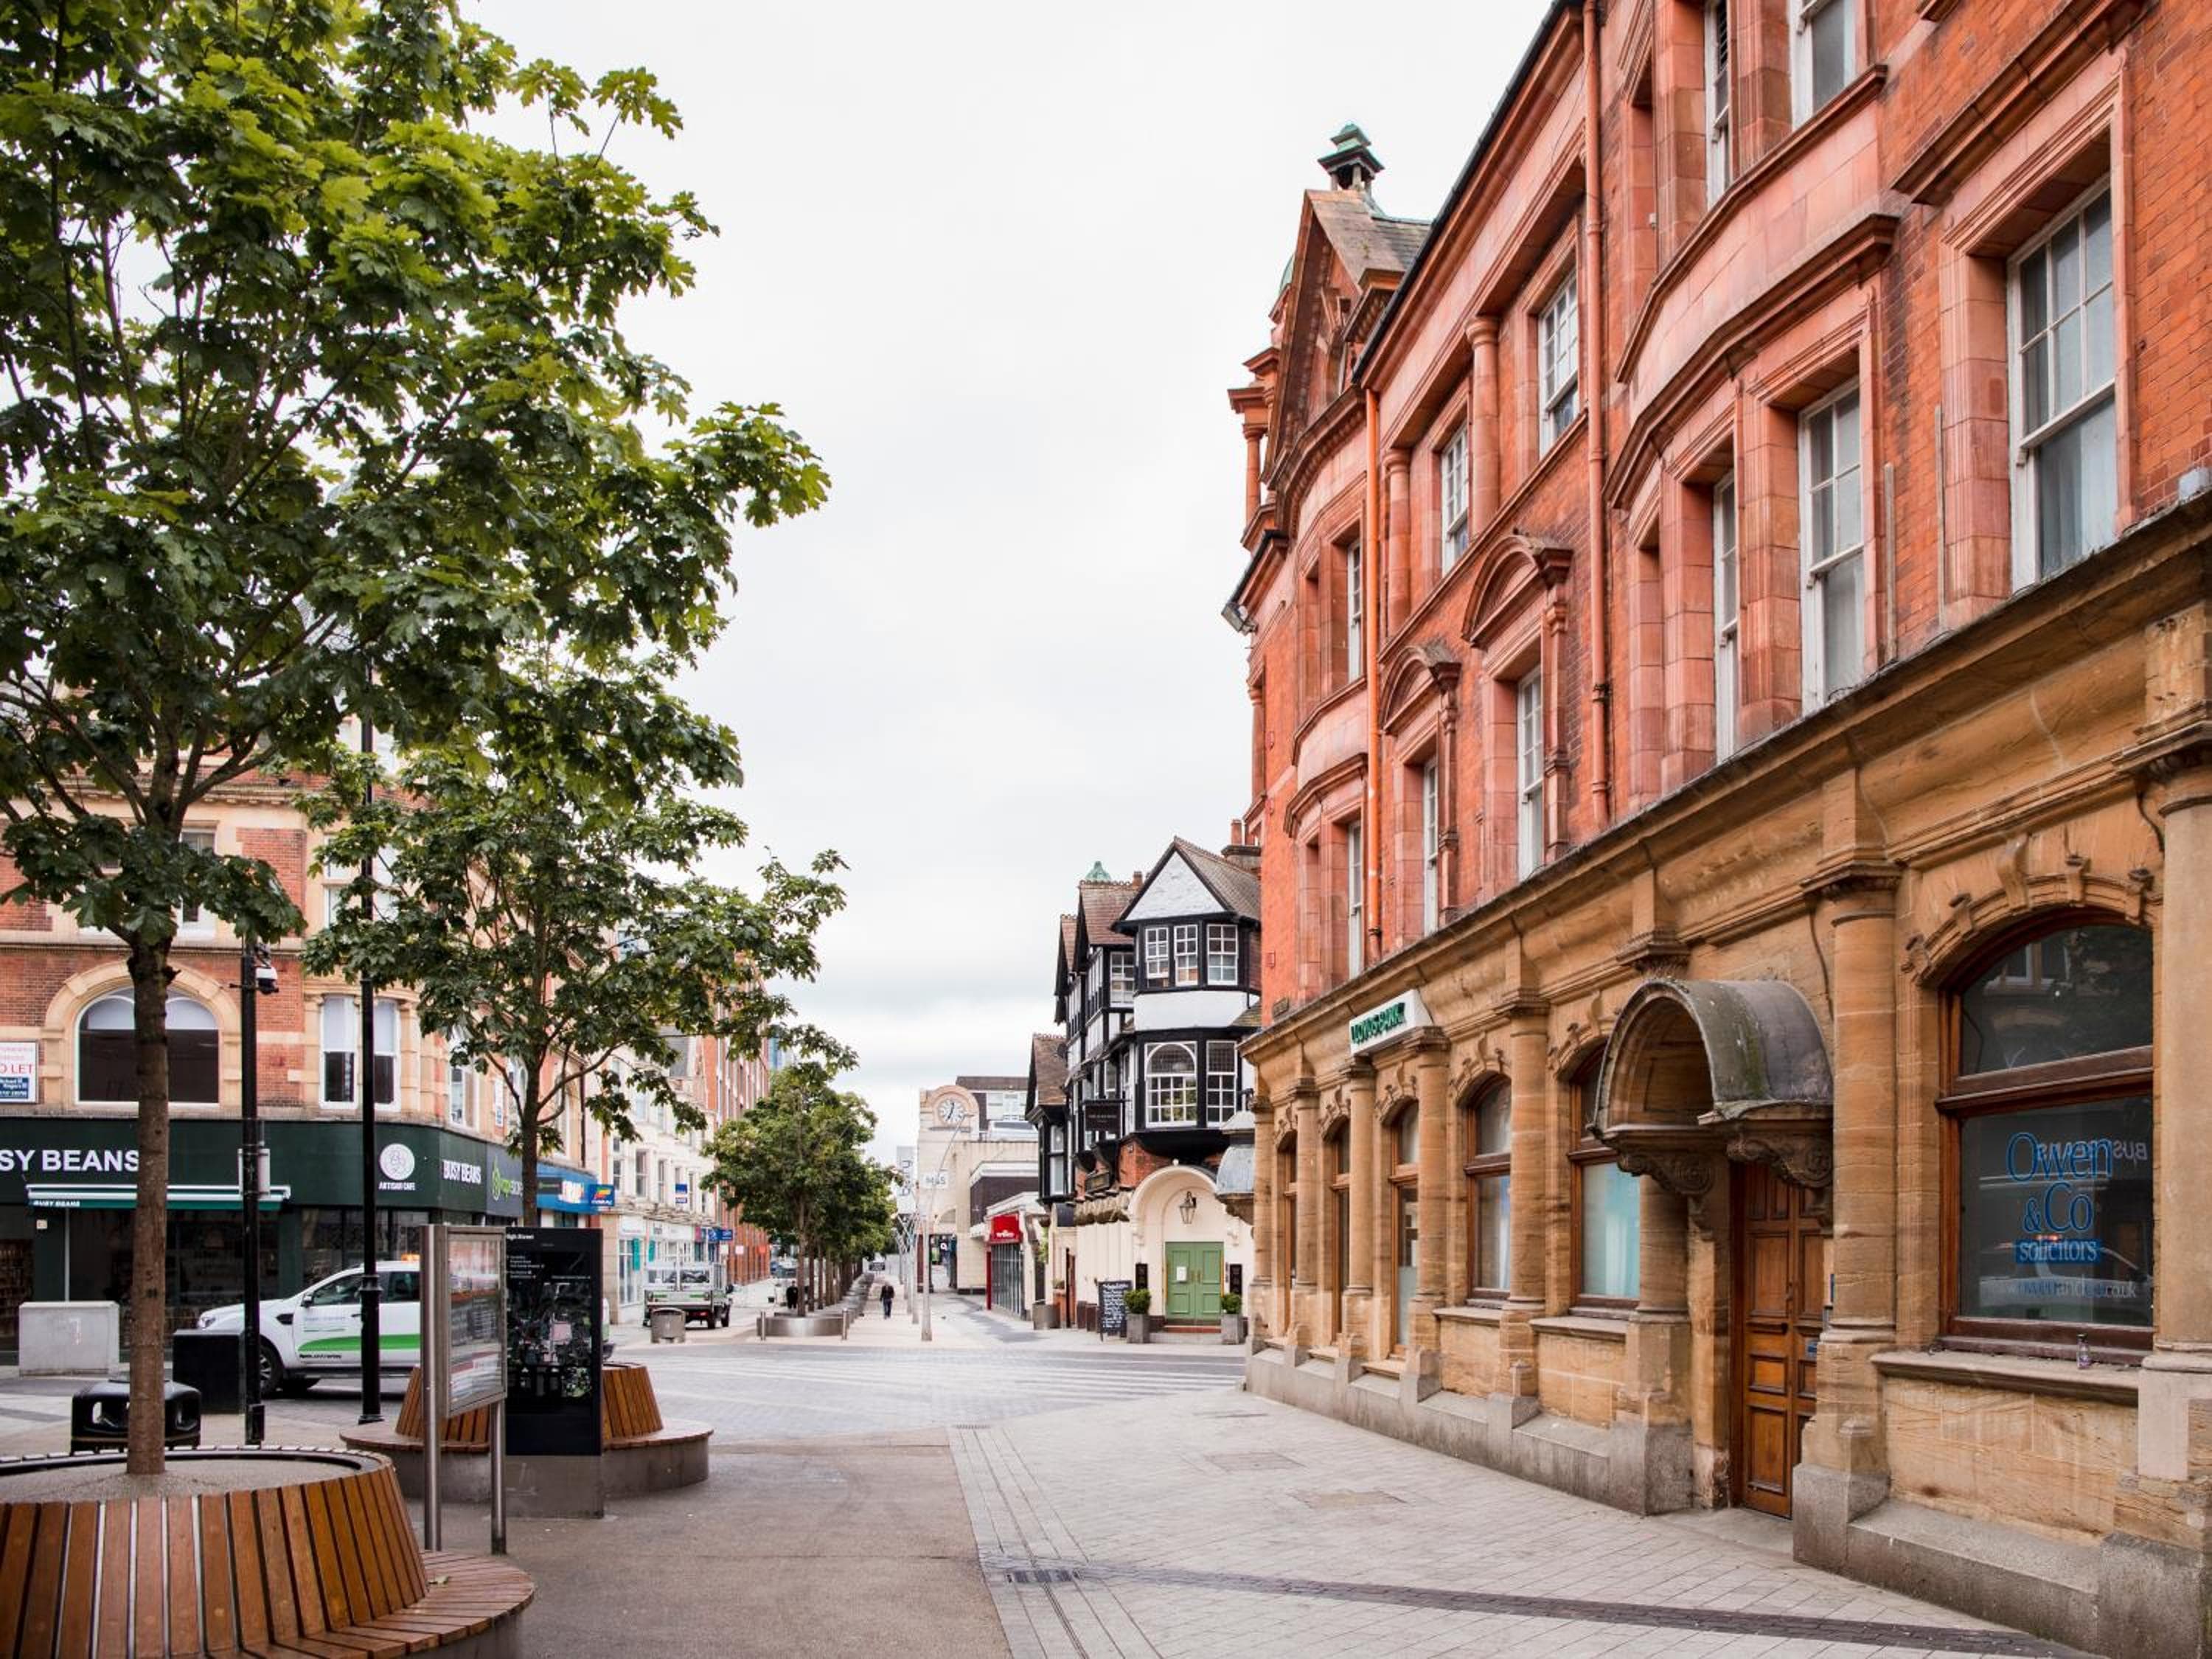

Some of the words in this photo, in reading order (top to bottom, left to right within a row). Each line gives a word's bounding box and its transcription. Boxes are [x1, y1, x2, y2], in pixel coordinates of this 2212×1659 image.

[11, 1064, 32, 1074] LET
[0, 1150, 35, 1172] SY
[42, 1150, 139, 1172] BEANS
[2006, 1132, 2112, 1181] Owen
[443, 1160, 461, 1180] BUSY
[461, 1163, 481, 1185] BEANS
[378, 1181, 403, 1191] ARTISAN
[2023, 1197, 2041, 1233] &
[2044, 1181, 2093, 1232] Co
[2019, 1239, 2098, 1262] solicitors
